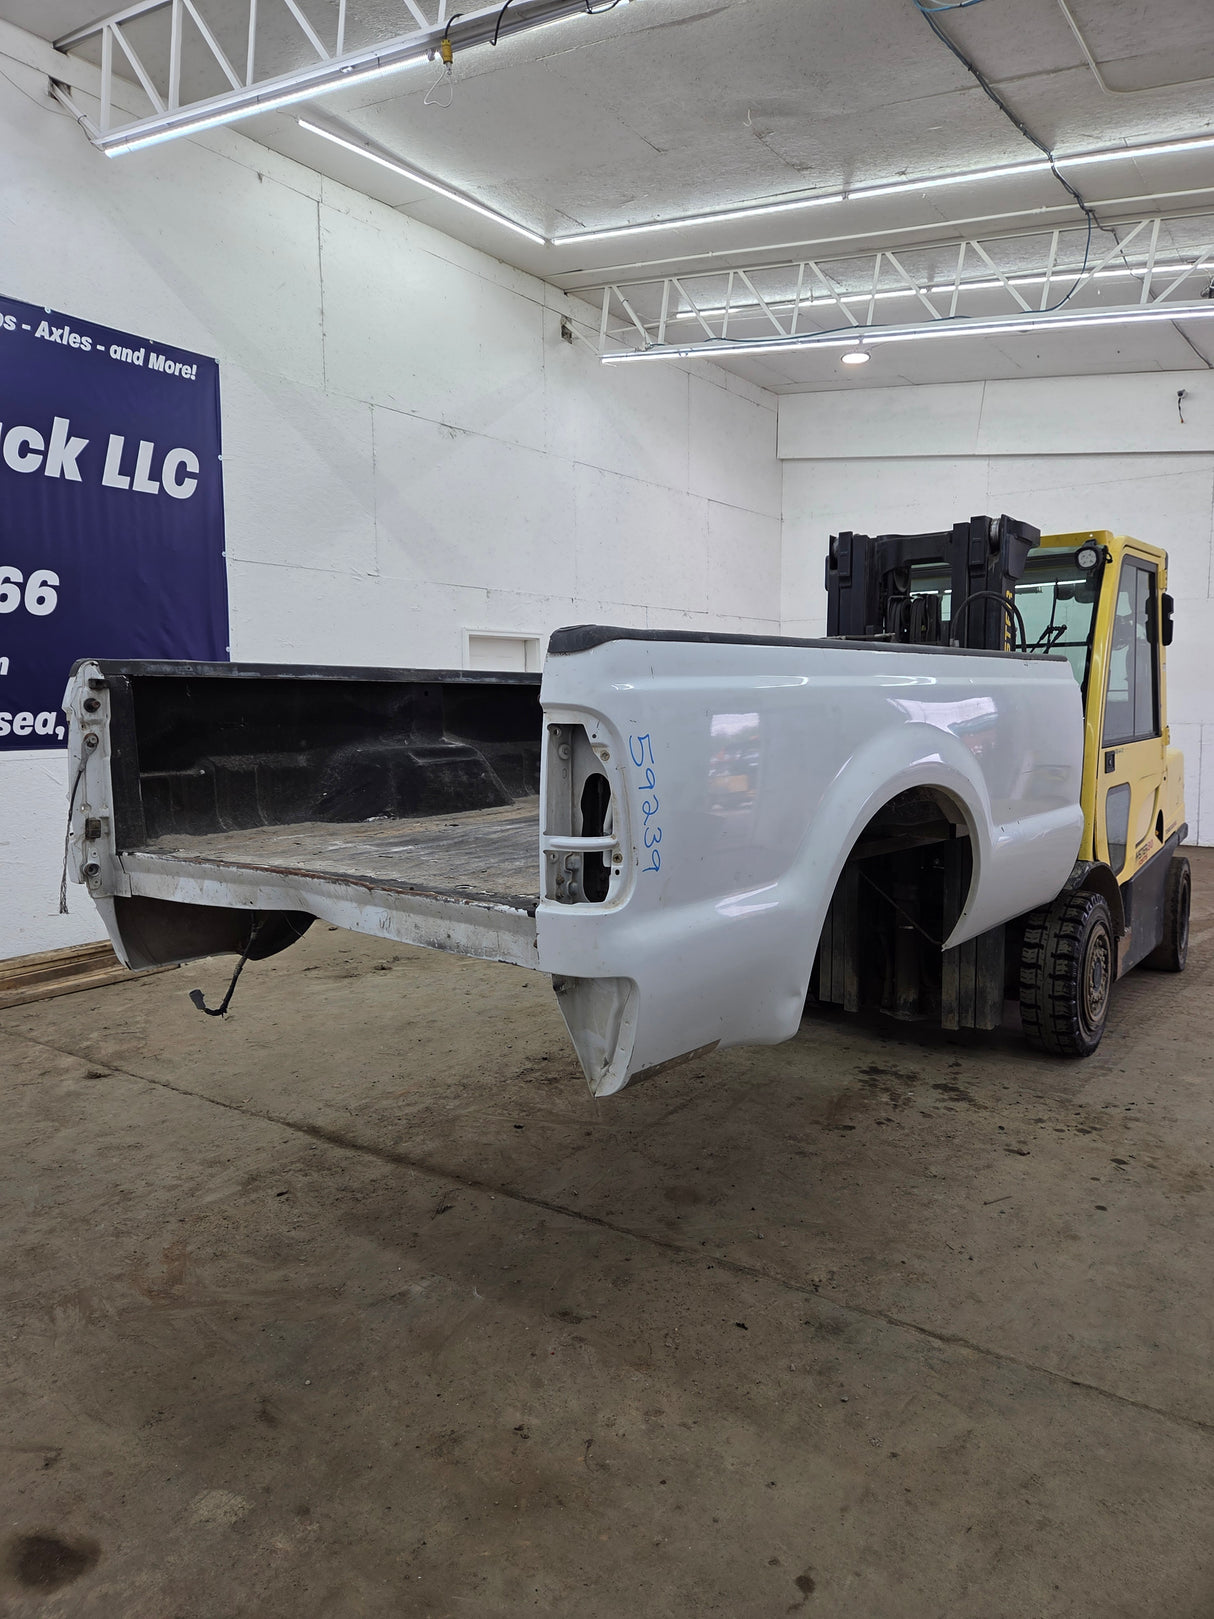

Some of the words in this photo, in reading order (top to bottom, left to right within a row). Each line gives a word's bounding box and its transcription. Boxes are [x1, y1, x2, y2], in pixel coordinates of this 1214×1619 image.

[35, 320, 92, 351] Axles
[109, 344, 145, 366] and
[148, 352, 197, 380] More!
[0, 416, 90, 482] ck
[101, 433, 200, 499] LLC
[629, 733, 662, 872] 59239
